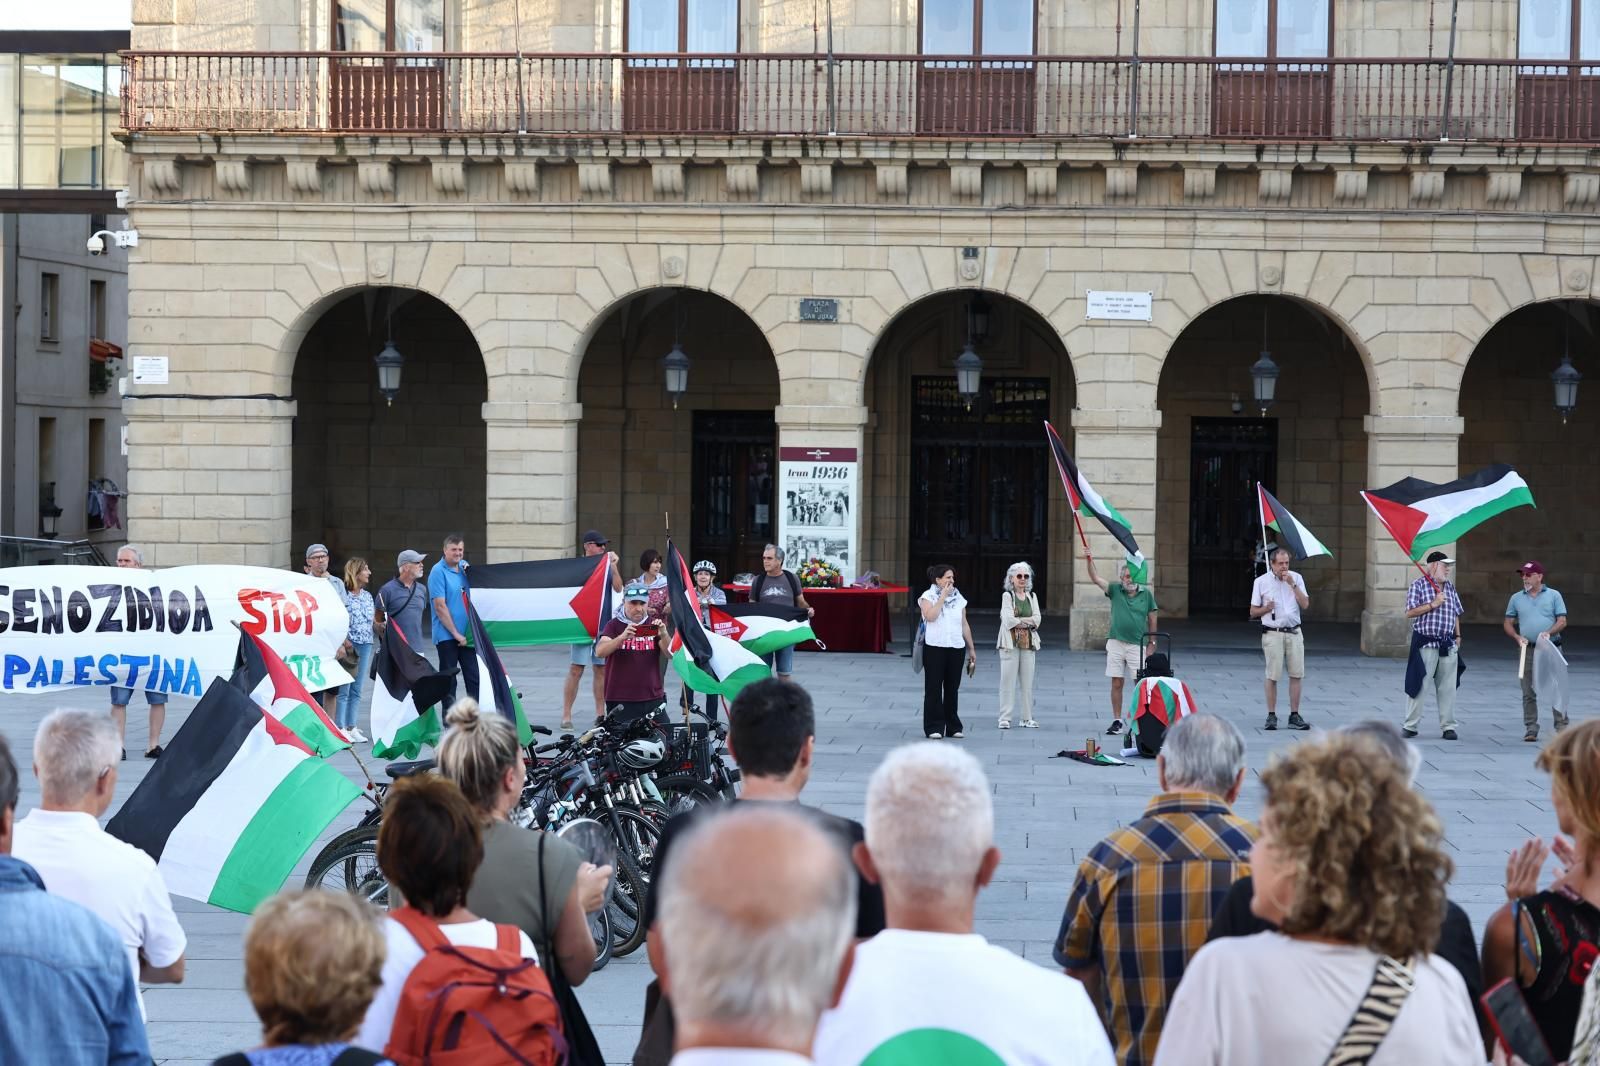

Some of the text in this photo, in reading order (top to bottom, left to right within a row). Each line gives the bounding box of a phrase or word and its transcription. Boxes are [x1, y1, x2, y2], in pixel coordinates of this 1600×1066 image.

[788, 466, 848, 479] Irun 1936
[237, 588, 319, 635] STOP
[2, 654, 203, 697] PALESTINA
